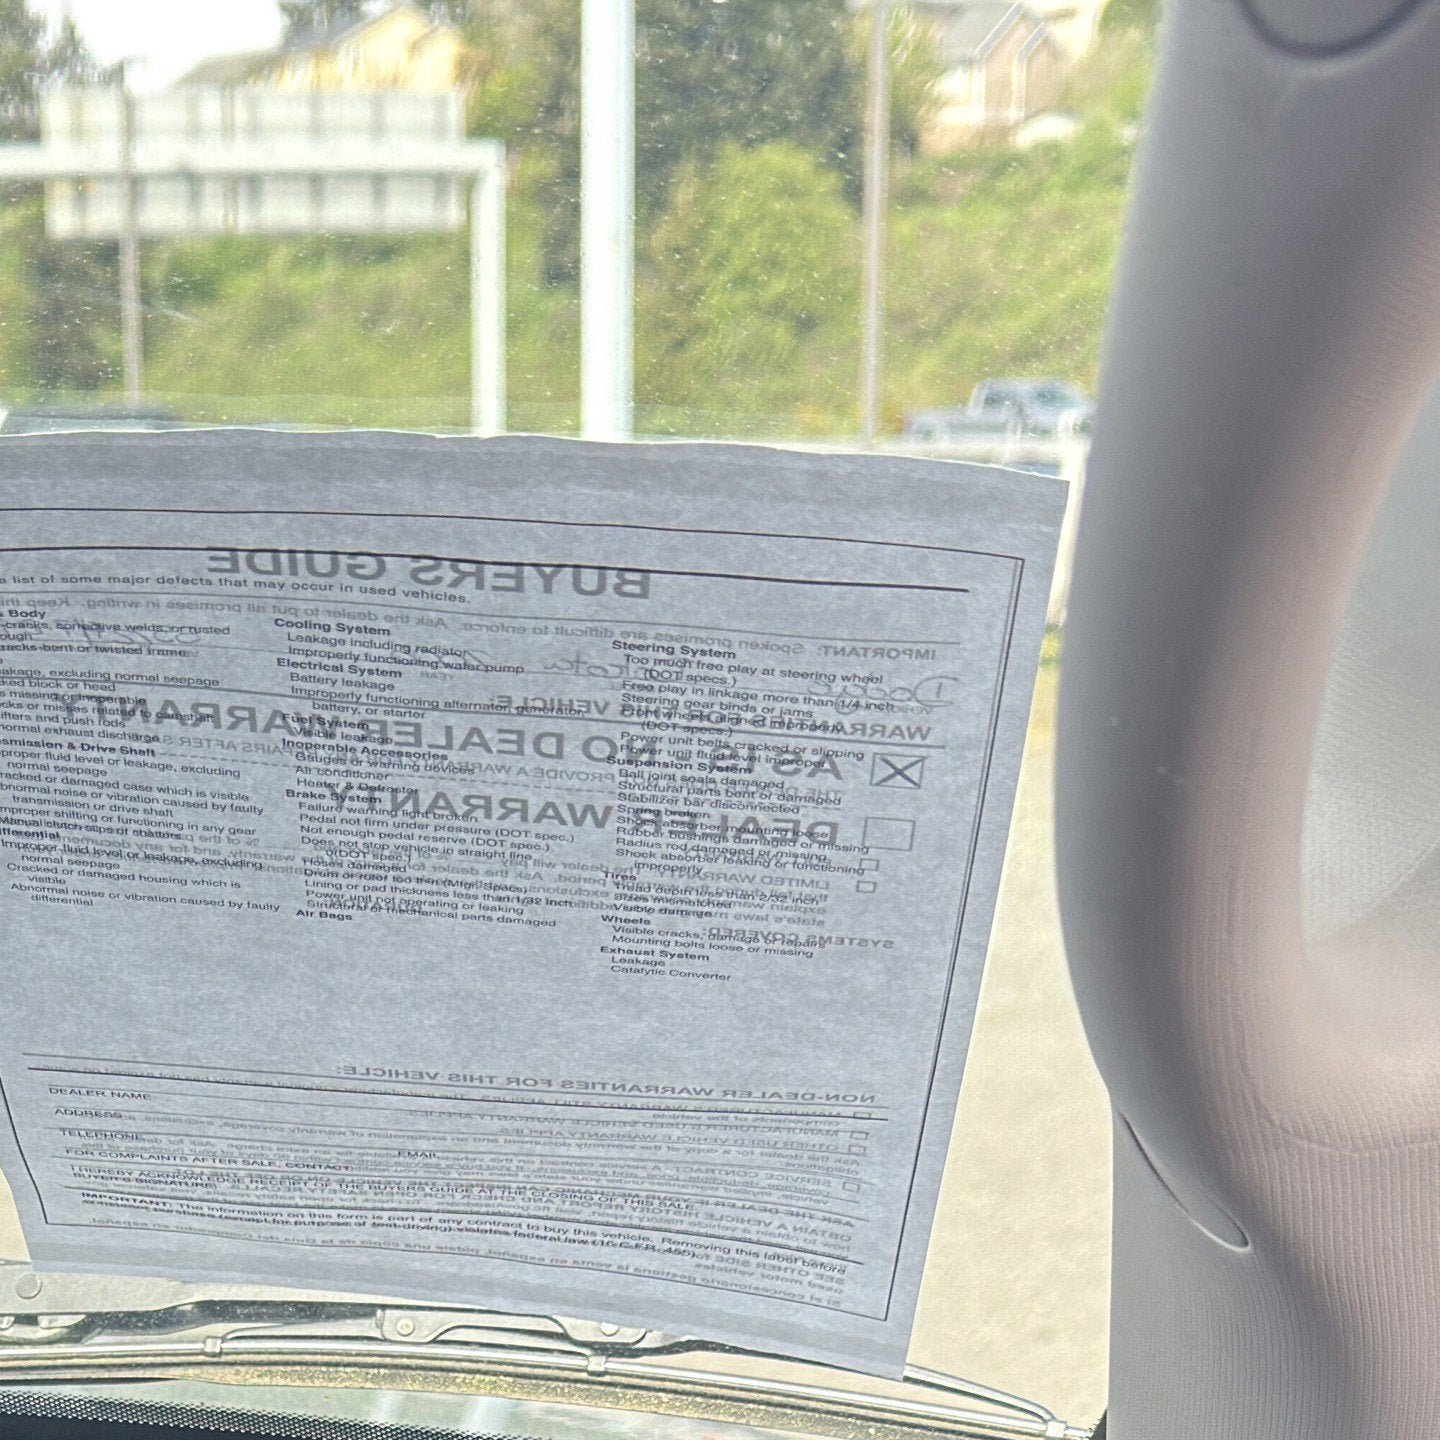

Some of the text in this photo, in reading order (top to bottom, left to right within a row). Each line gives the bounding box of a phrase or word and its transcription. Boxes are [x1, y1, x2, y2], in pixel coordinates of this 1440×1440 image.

[13, 576, 35, 584] list
[108, 576, 150, 584] major
[157, 576, 212, 586] defects
[220, 578, 247, 587] that
[254, 580, 285, 590] may
[292, 582, 333, 591] occur
[341, 583, 352, 593] in
[360, 586, 396, 596] used
[403, 589, 470, 603] vehicles.
[9, 610, 46, 619] Body
[275, 619, 390, 636] Cooling System
[612, 640, 736, 659] Steering System
[277, 658, 402, 678] Electrical System
[625, 654, 882, 684] Too much free play at steering wheel
[290, 672, 395, 692] Battery leakage
[68, 742, 76, 750] &
[81, 743, 116, 754] Drive
[120, 746, 155, 757] Shaft
[282, 739, 448, 761] Inoperable Accessories
[8, 761, 107, 777] normal seepage
[45, 751, 70, 761] fluid
[75, 754, 103, 764] level
[108, 758, 120, 766] or
[124, 759, 179, 772] leakage,
[181, 765, 240, 779] excluding
[45, 775, 56, 783] or
[61, 776, 119, 789] damaged
[123, 783, 152, 792] case
[157, 786, 192, 797] which
[196, 789, 206, 798] is
[210, 791, 249, 801] visible
[286, 790, 382, 804] Brake System
[13, 795, 173, 817] transmission or drive shaft
[54, 787, 87, 798] noise
[91, 791, 102, 799] or
[107, 792, 159, 804] vibration
[163, 798, 207, 809] caused
[212, 802, 226, 812] by
[230, 804, 263, 816] faulty
[54, 810, 97, 822] shifting
[102, 815, 113, 823] or
[118, 815, 184, 831] functioning
[188, 822, 198, 830] in
[202, 825, 224, 835] any
[228, 827, 256, 836] gear
[300, 813, 575, 843] Pedal not firm under pressure (DOT spec.)
[300, 825, 550, 852] Not enough pedal reserve (DOT spec.)
[296, 909, 352, 921] Air Bags
[601, 915, 651, 926] Wheels
[600, 946, 709, 962] Exhaust System
[611, 956, 665, 967] Leakage
[611, 966, 731, 981] Catalytic Converter
[50, 1088, 152, 1100] DEALER NAME
[55, 1108, 122, 1118] ADDRESS
[60, 1130, 144, 1140] TELEPHONE
